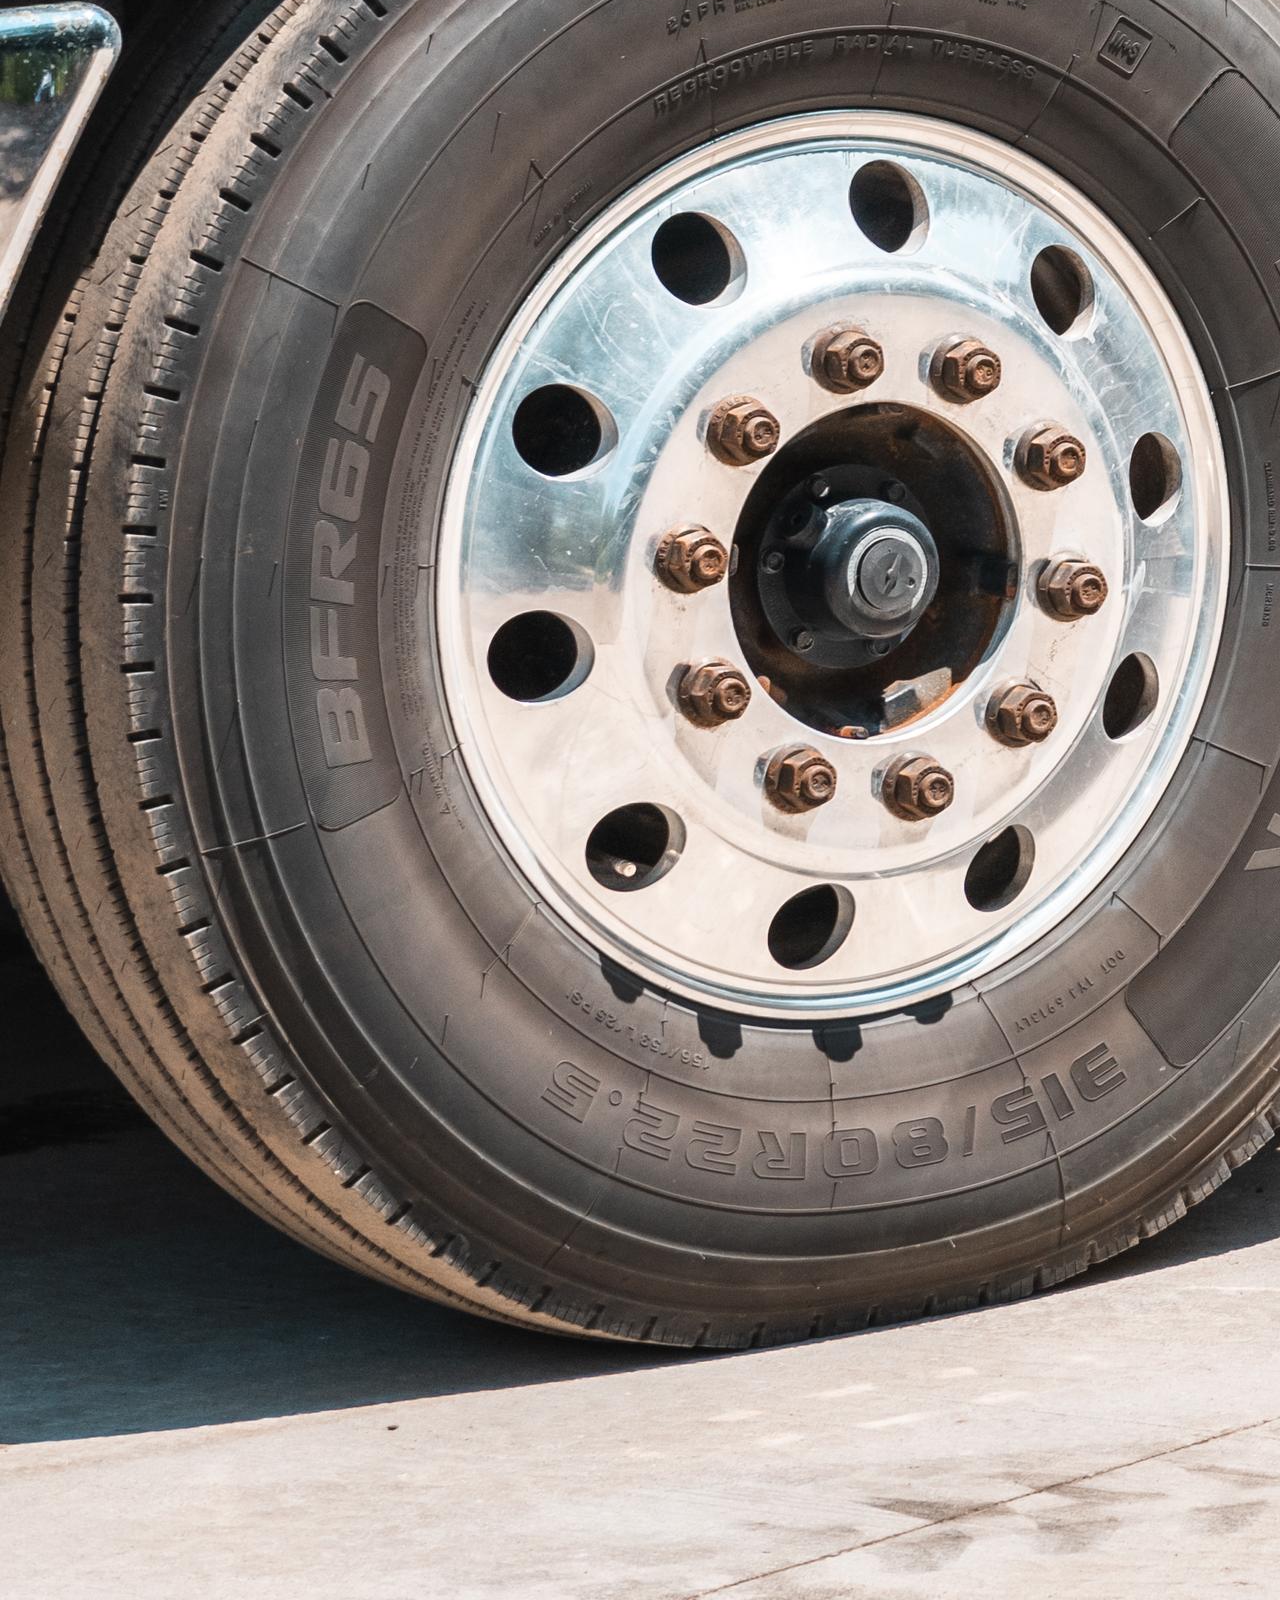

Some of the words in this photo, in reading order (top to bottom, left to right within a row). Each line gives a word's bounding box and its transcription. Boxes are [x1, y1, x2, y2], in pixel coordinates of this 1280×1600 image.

[653, 39, 814, 116] REGROOVABLE
[833, 33, 915, 52] RADIAL
[931, 38, 1039, 81] TUBELESS
[309, 352, 392, 768] BFR65
[1100, 949, 1127, 975] DOT
[541, 1041, 1128, 1180] 315/80R22.5
